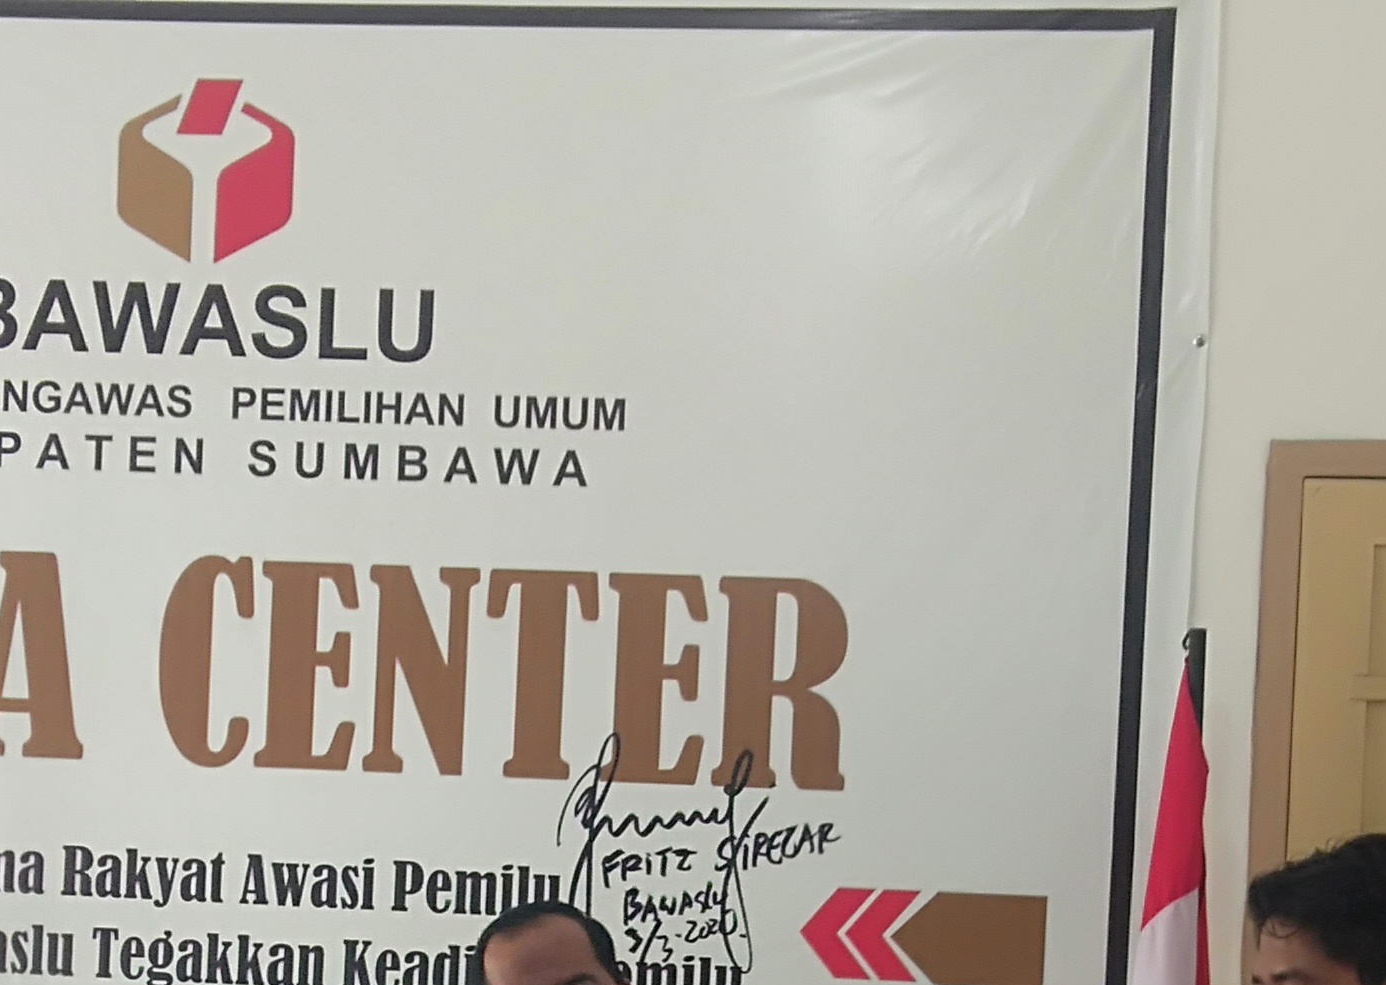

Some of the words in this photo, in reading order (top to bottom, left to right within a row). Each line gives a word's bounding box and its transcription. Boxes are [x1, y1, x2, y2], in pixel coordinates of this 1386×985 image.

[232, 386, 465, 427] PEMILIHAN
[494, 395, 627, 431] UMUM
[248, 439, 588, 487] SUMBAWA
[159, 555, 848, 791] CENTER
[60, 845, 227, 908] Rakyat
[239, 853, 375, 911] Awasi
[391, 860, 561, 914] Pemilu
[601, 846, 697, 888] FRITZ
